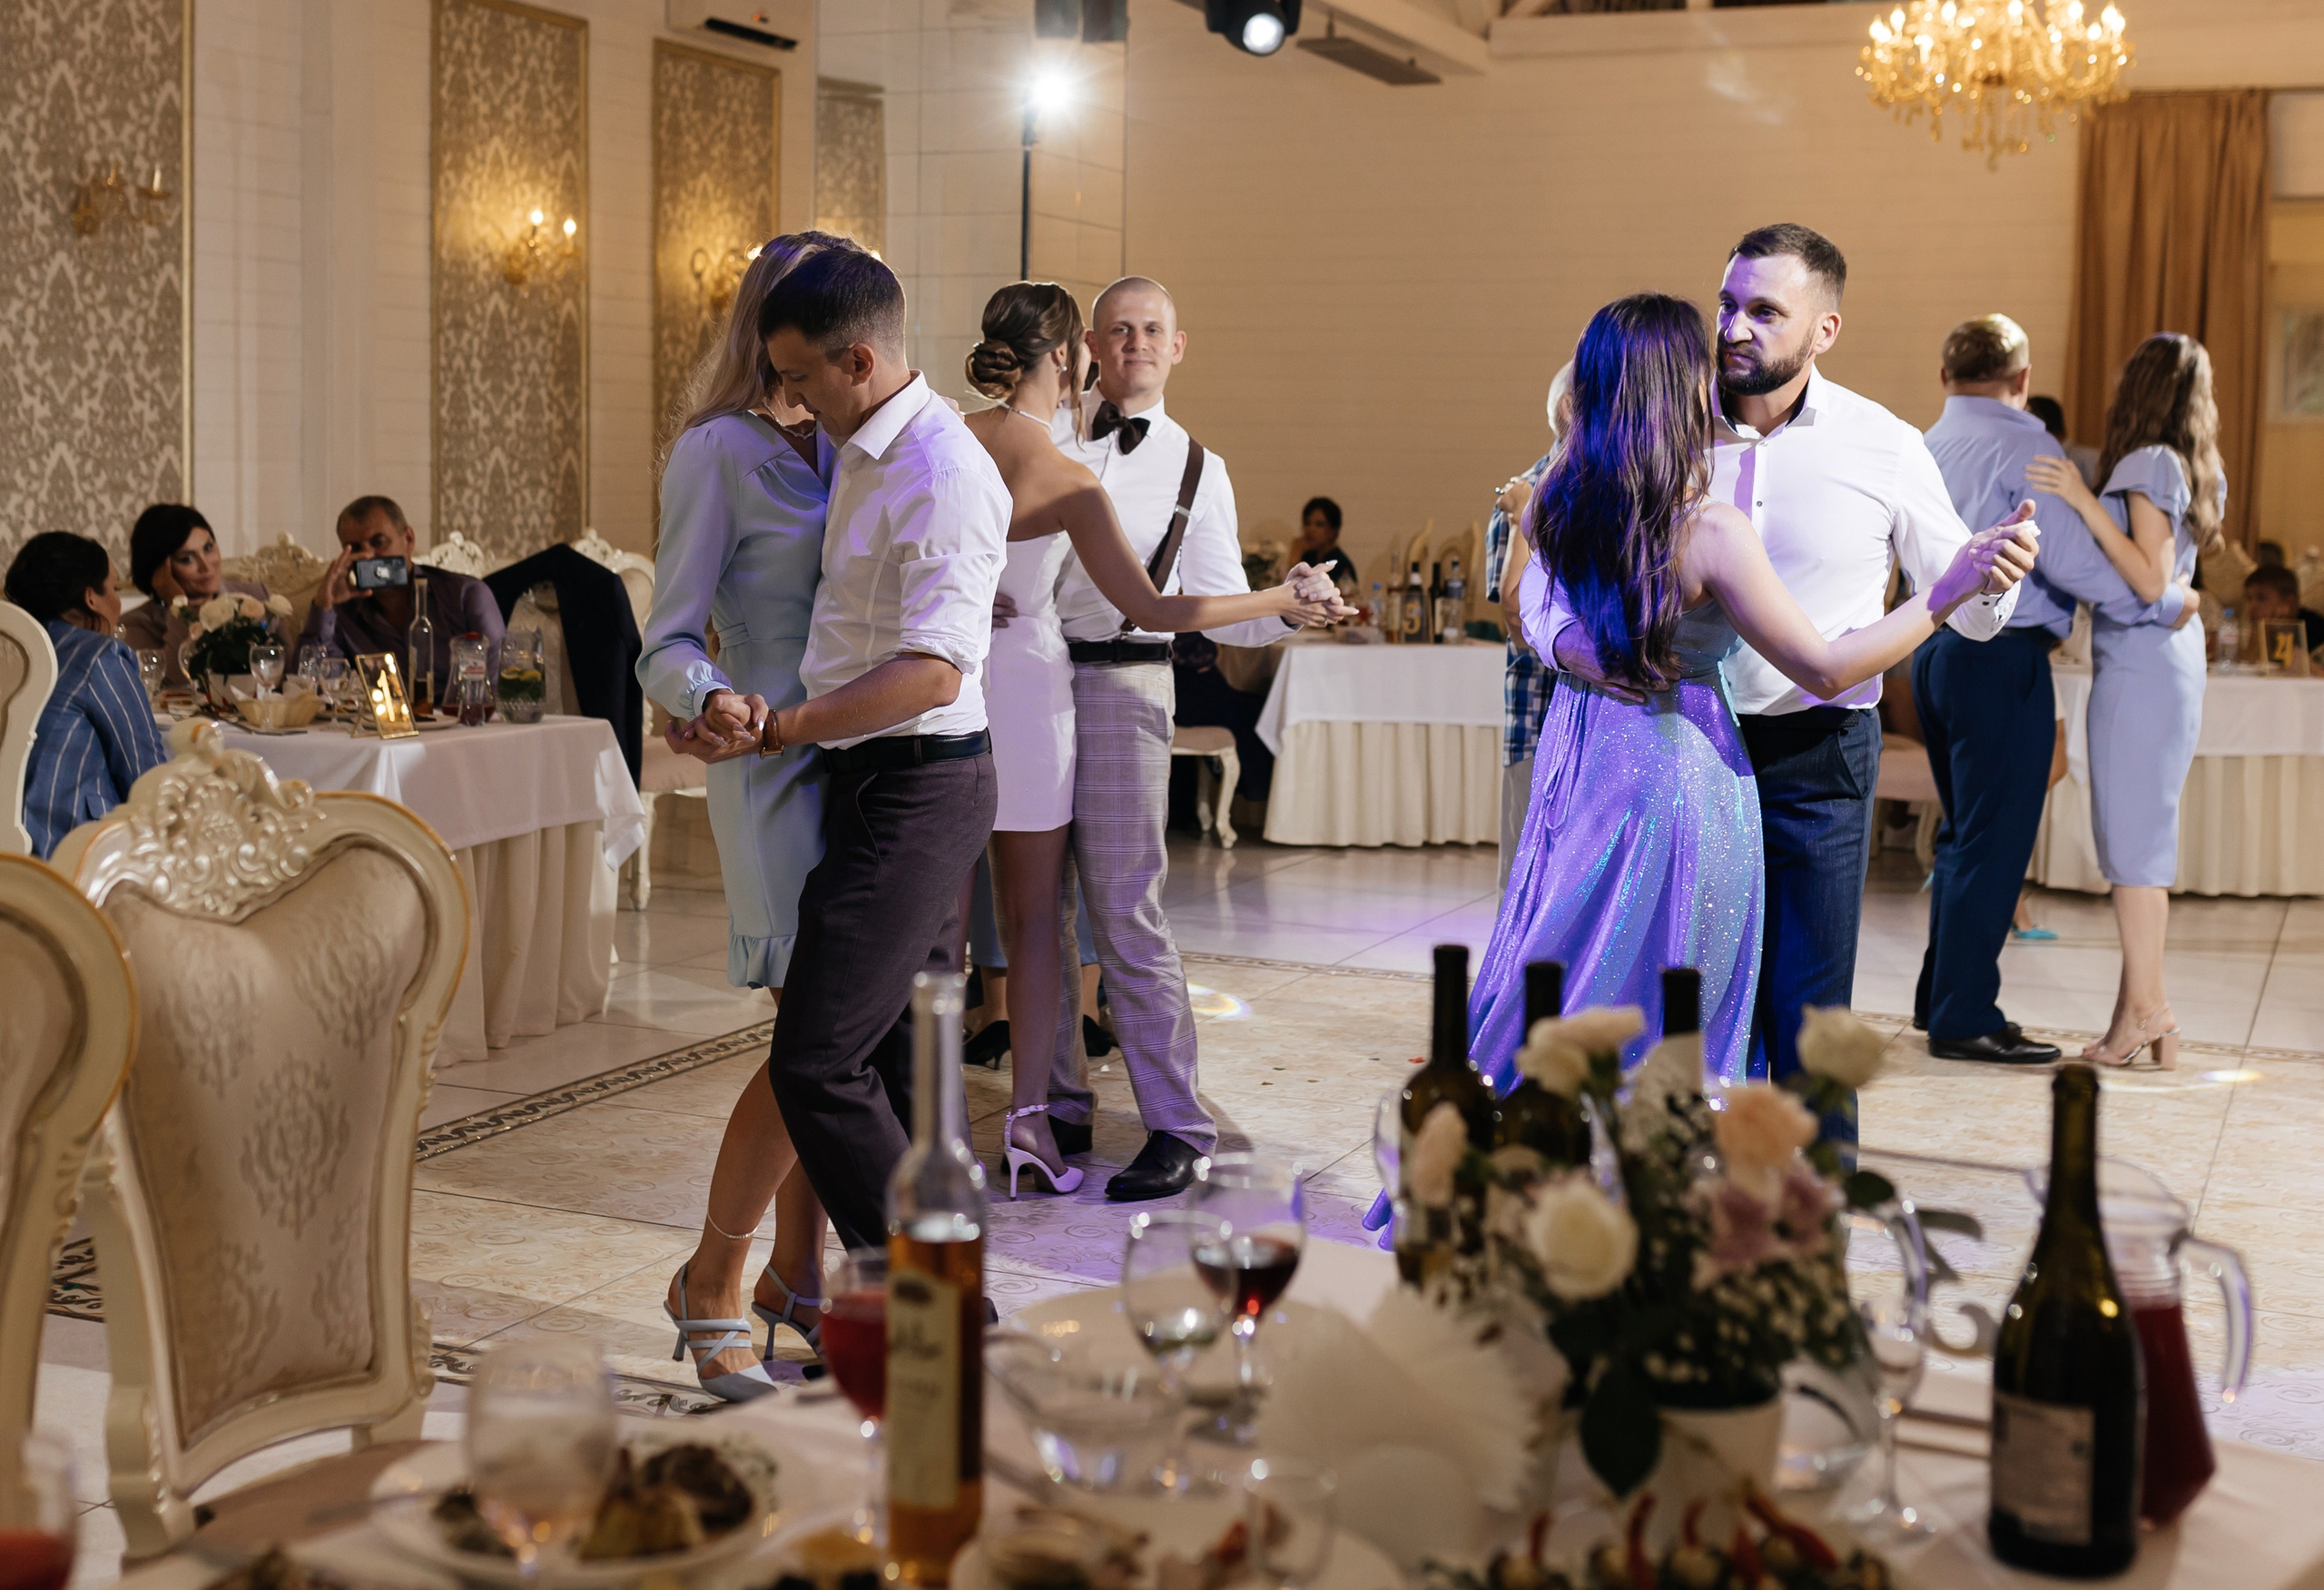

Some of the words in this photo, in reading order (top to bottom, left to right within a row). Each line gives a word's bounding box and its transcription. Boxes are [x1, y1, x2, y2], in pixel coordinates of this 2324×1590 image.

[1403, 601, 1422, 634] 5
[2274, 632, 2294, 667] 4
[377, 669, 395, 722] 1
